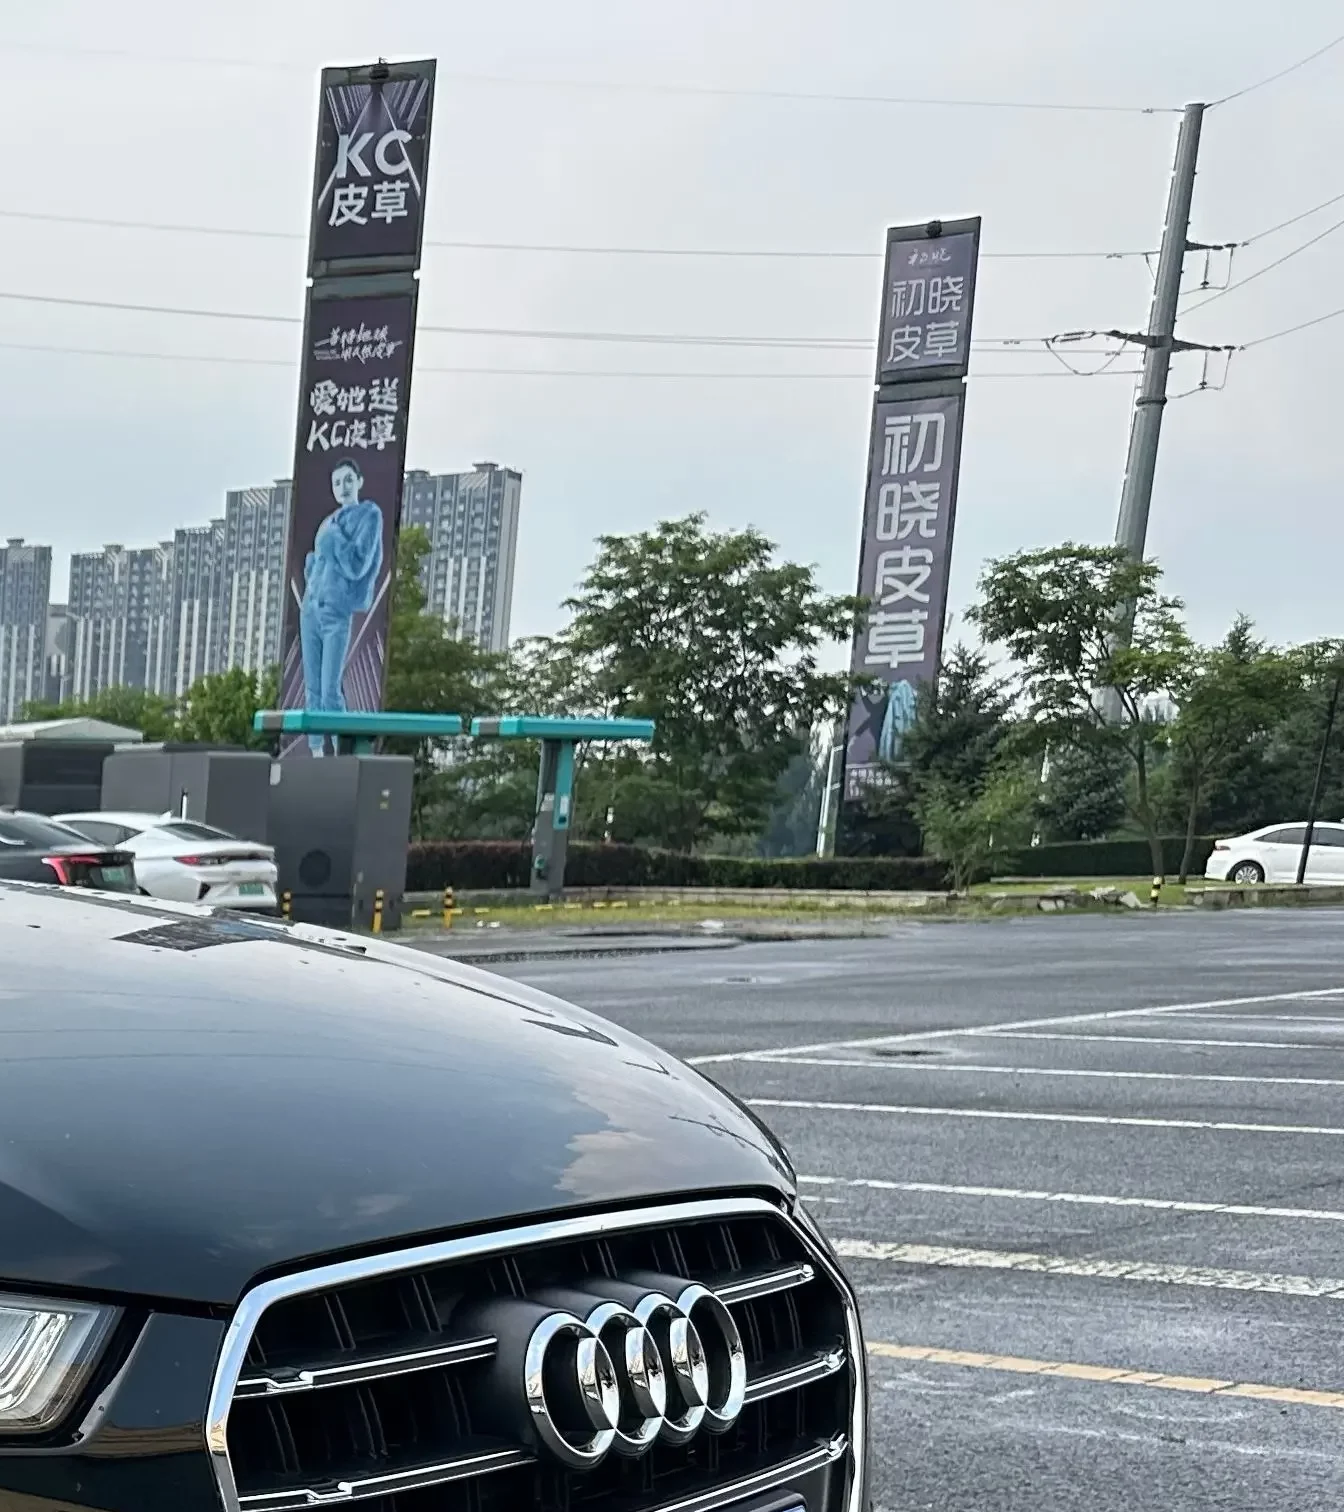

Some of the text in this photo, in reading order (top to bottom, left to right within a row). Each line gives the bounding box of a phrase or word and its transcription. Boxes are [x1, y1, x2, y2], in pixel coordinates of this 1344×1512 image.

[336, 130, 413, 180] KC
[327, 180, 410, 228] 皮草
[892, 276, 964, 318] 初晓
[887, 320, 960, 363] 皮草
[310, 377, 399, 416] 爱她送
[306, 414, 397, 452] KC皮草
[863, 411, 946, 669] 初晓皮草
